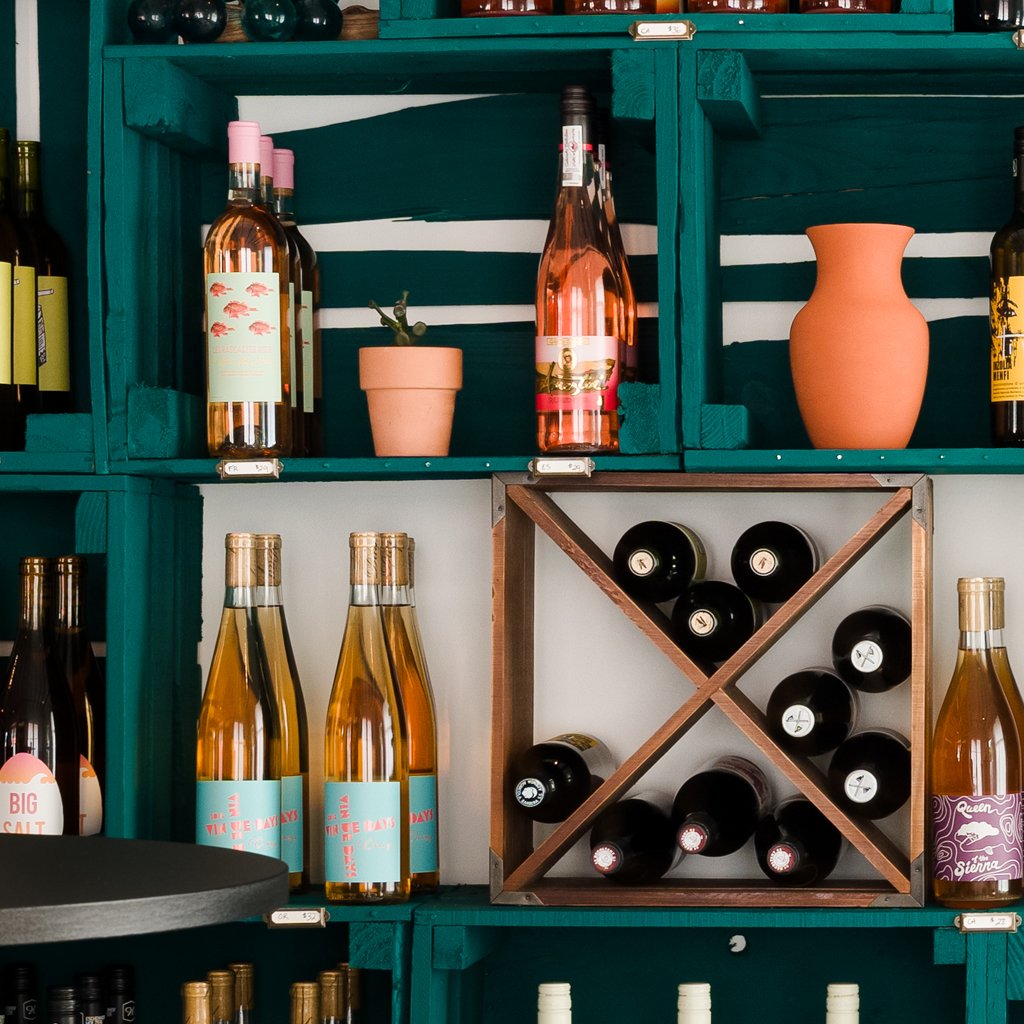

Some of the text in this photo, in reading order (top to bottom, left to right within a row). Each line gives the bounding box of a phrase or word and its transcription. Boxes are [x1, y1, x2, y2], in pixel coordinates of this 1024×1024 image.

[9, 792, 38, 815] BIG
[956, 801, 992, 819] Queen
[280, 809, 298, 824] AYS
[954, 860, 1000, 878] Sienna
